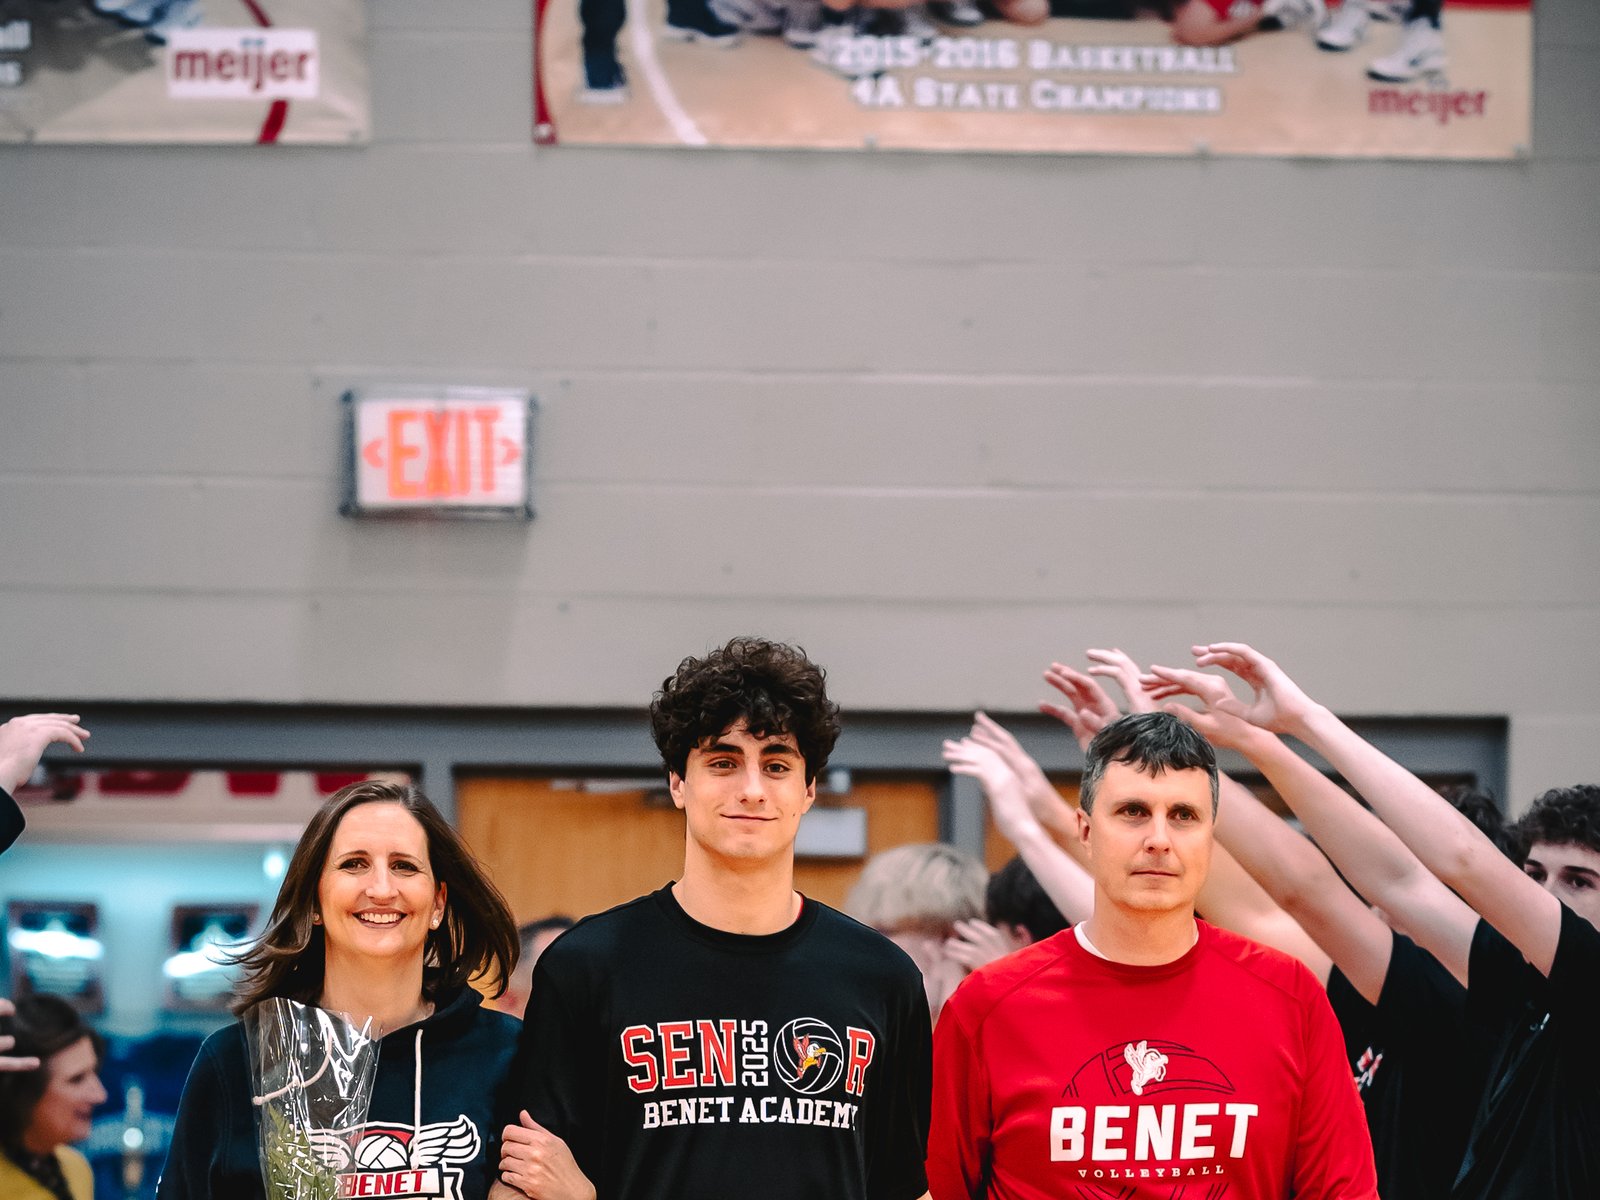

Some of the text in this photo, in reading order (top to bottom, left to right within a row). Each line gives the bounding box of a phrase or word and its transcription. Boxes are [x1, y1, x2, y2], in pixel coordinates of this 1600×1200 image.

[174, 38, 311, 90] meijer
[387, 408, 502, 499] EXIT
[741, 1019, 769, 1087] 2025
[642, 1097, 734, 1129] BENET
[1050, 1103, 1259, 1162] BENET
[341, 1170, 428, 1197] BENET
[1078, 1164, 1225, 1178] VOLLEYBALL
